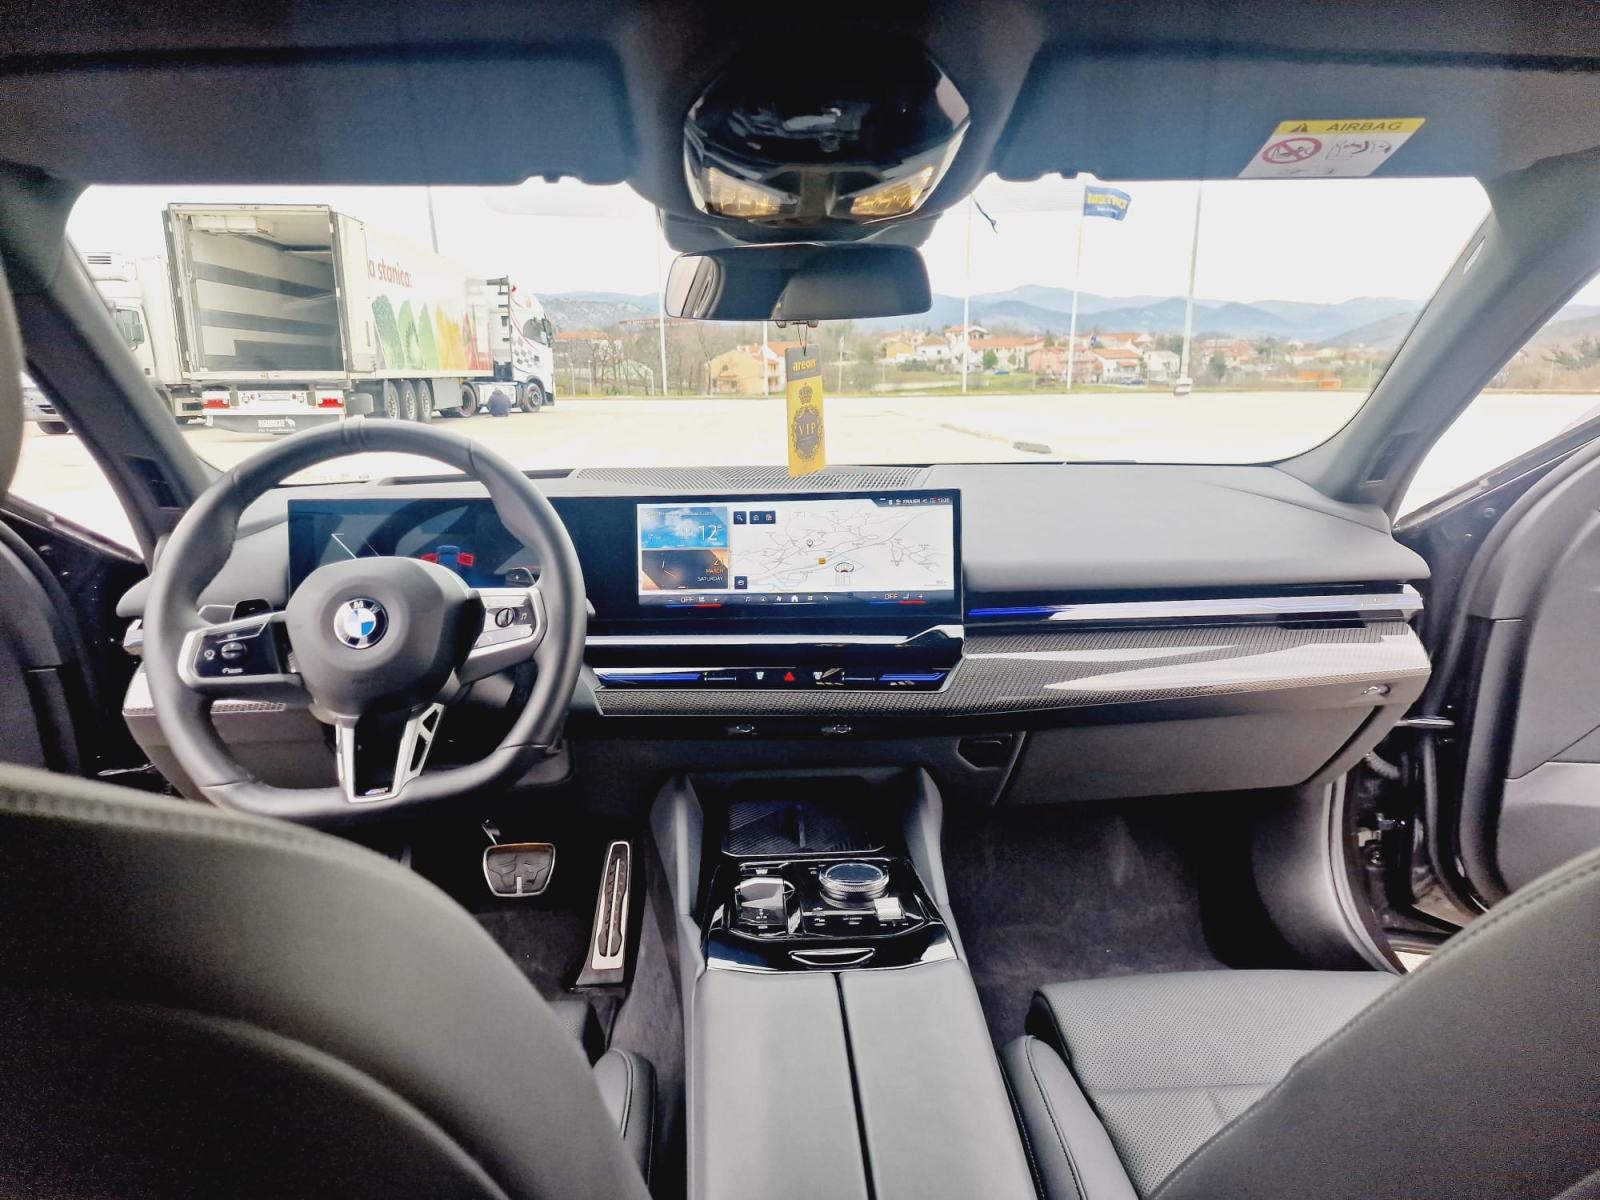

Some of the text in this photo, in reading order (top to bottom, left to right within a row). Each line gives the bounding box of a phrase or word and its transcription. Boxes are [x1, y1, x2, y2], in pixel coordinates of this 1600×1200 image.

[1325, 121, 1404, 132] AIRBAG
[793, 359, 816, 371] areon
[799, 423, 817, 435] VIP
